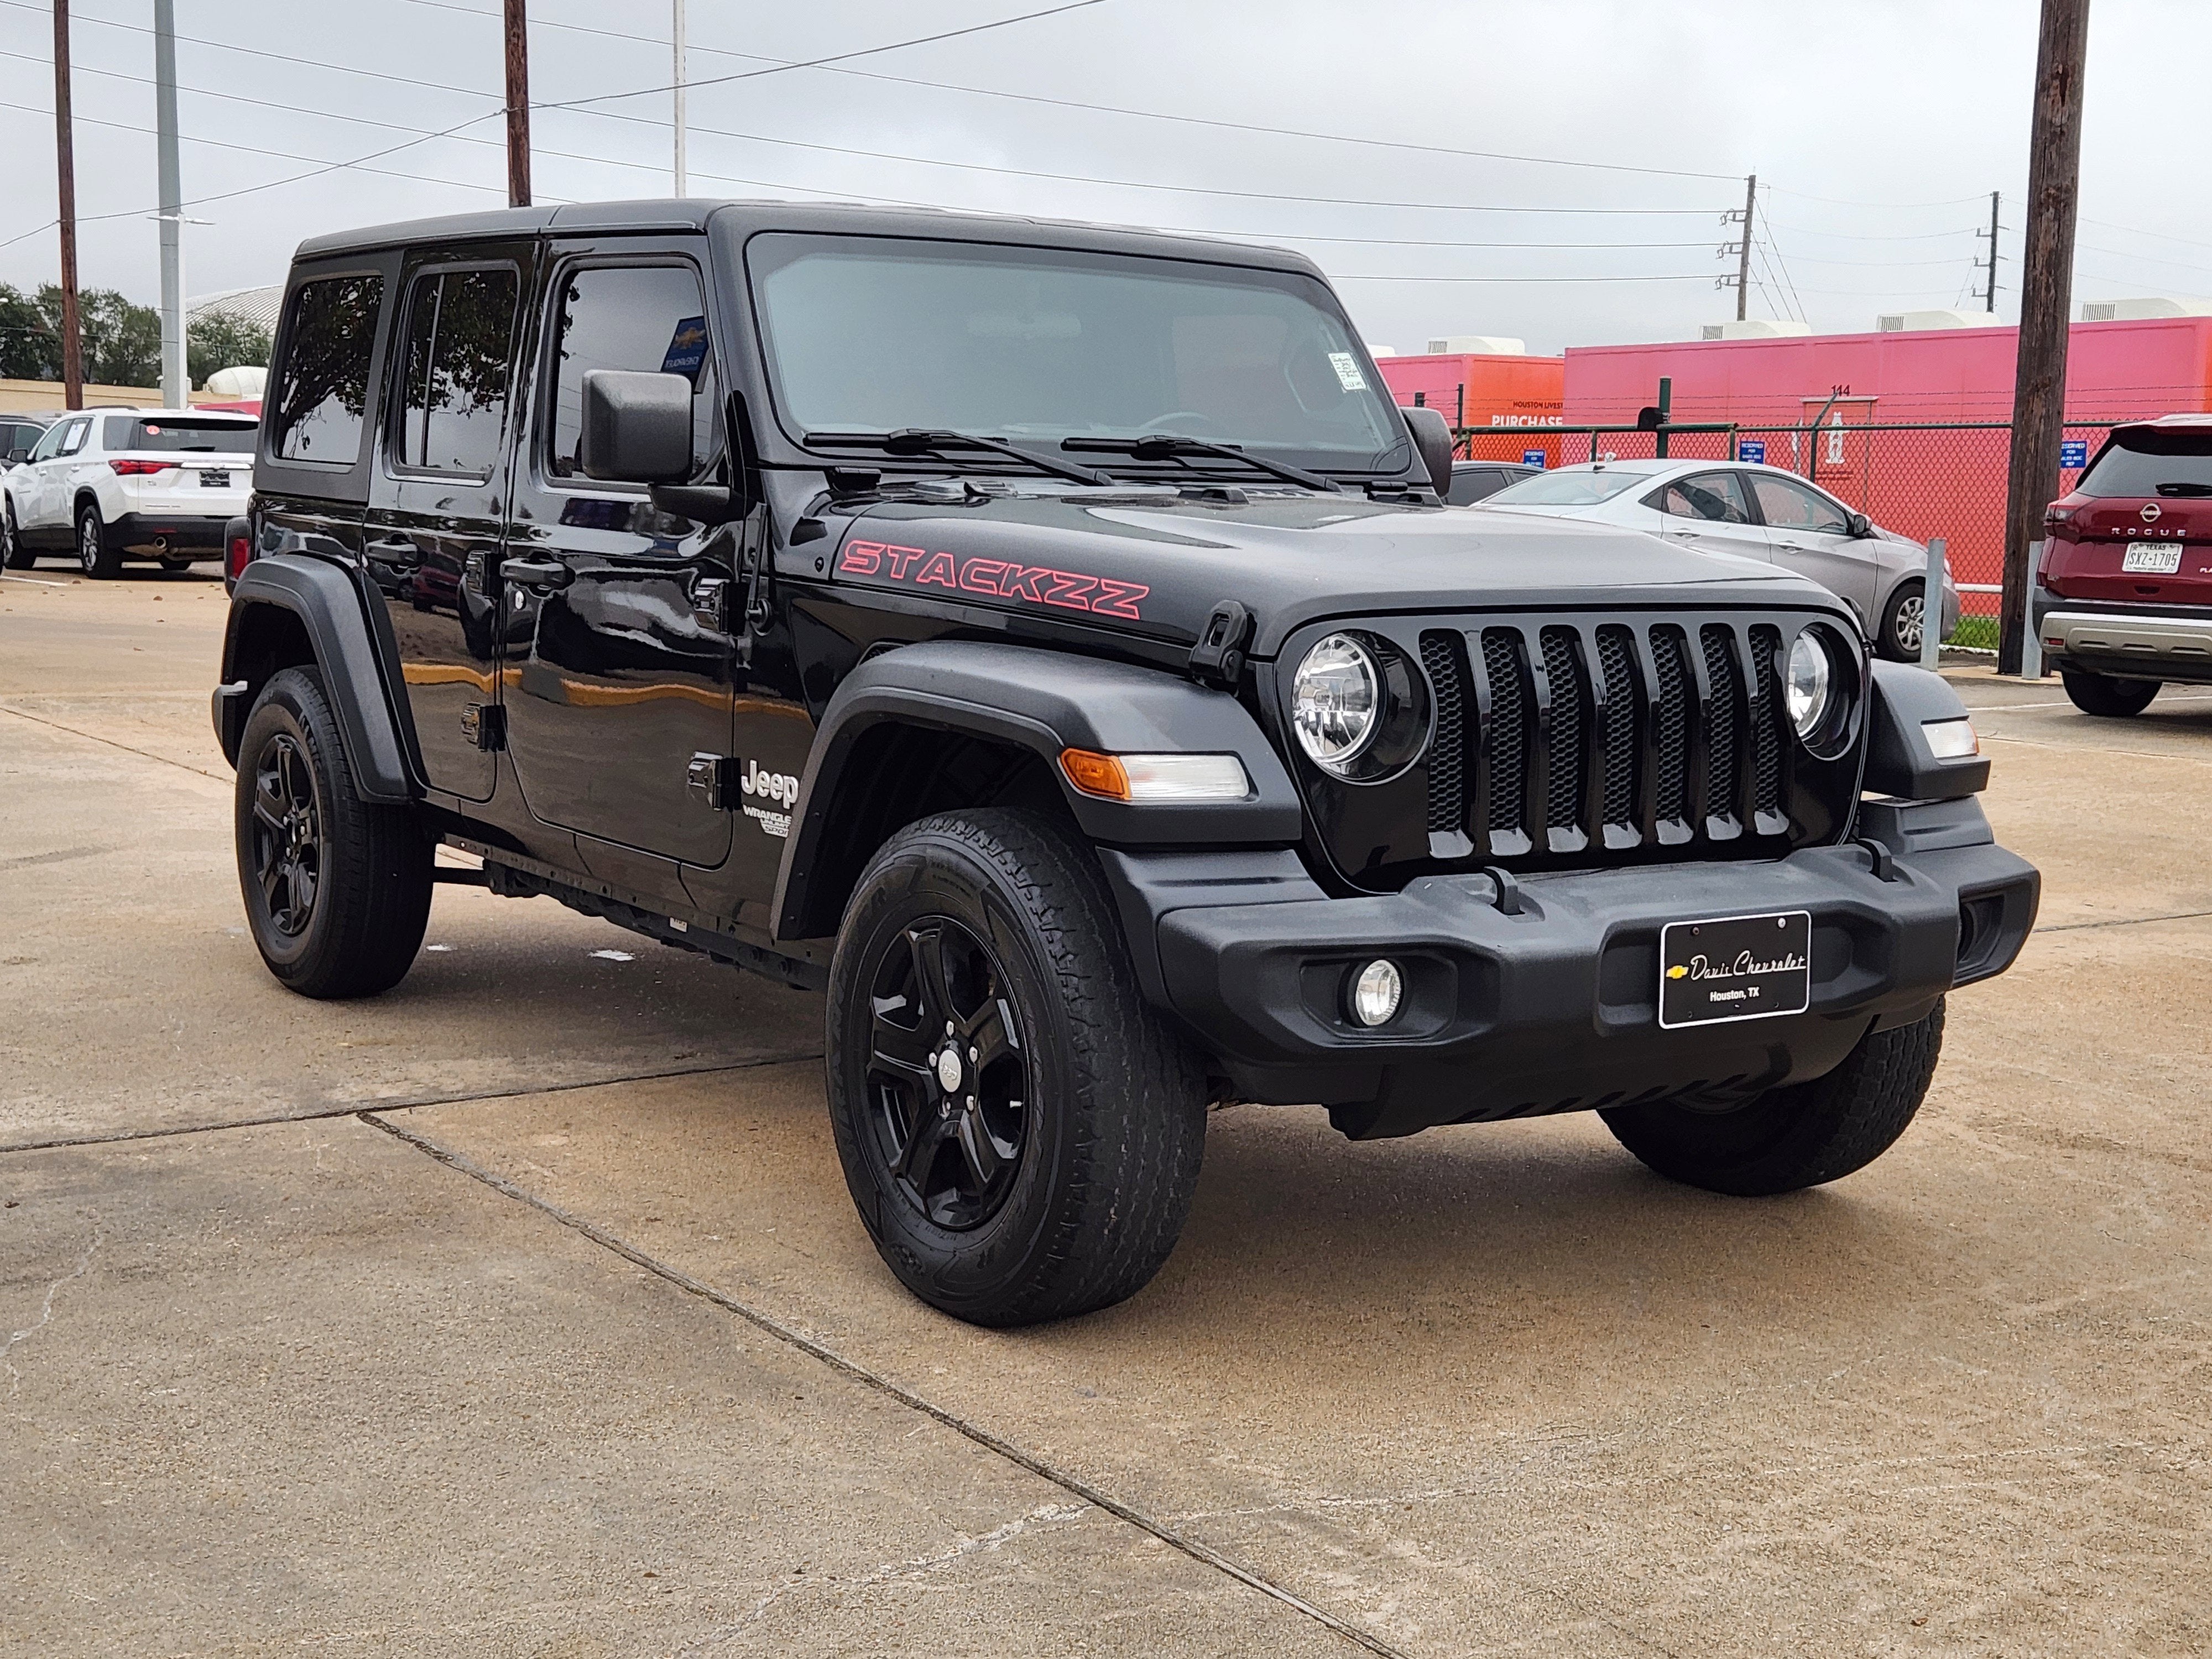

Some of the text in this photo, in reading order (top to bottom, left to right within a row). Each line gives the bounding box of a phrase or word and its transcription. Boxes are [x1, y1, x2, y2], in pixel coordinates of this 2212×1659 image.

[1492, 415, 1563, 426] PURCHASE
[2111, 527, 2187, 536] ROGUE
[840, 540, 1149, 620] STACKZZ
[741, 759, 799, 810] Jeep
[743, 804, 792, 825] WRANGLE
[760, 818, 790, 828] UNLIMIT
[1690, 950, 1807, 980] Davis Chevrolet
[1710, 987, 1760, 1001] Houston, TX
